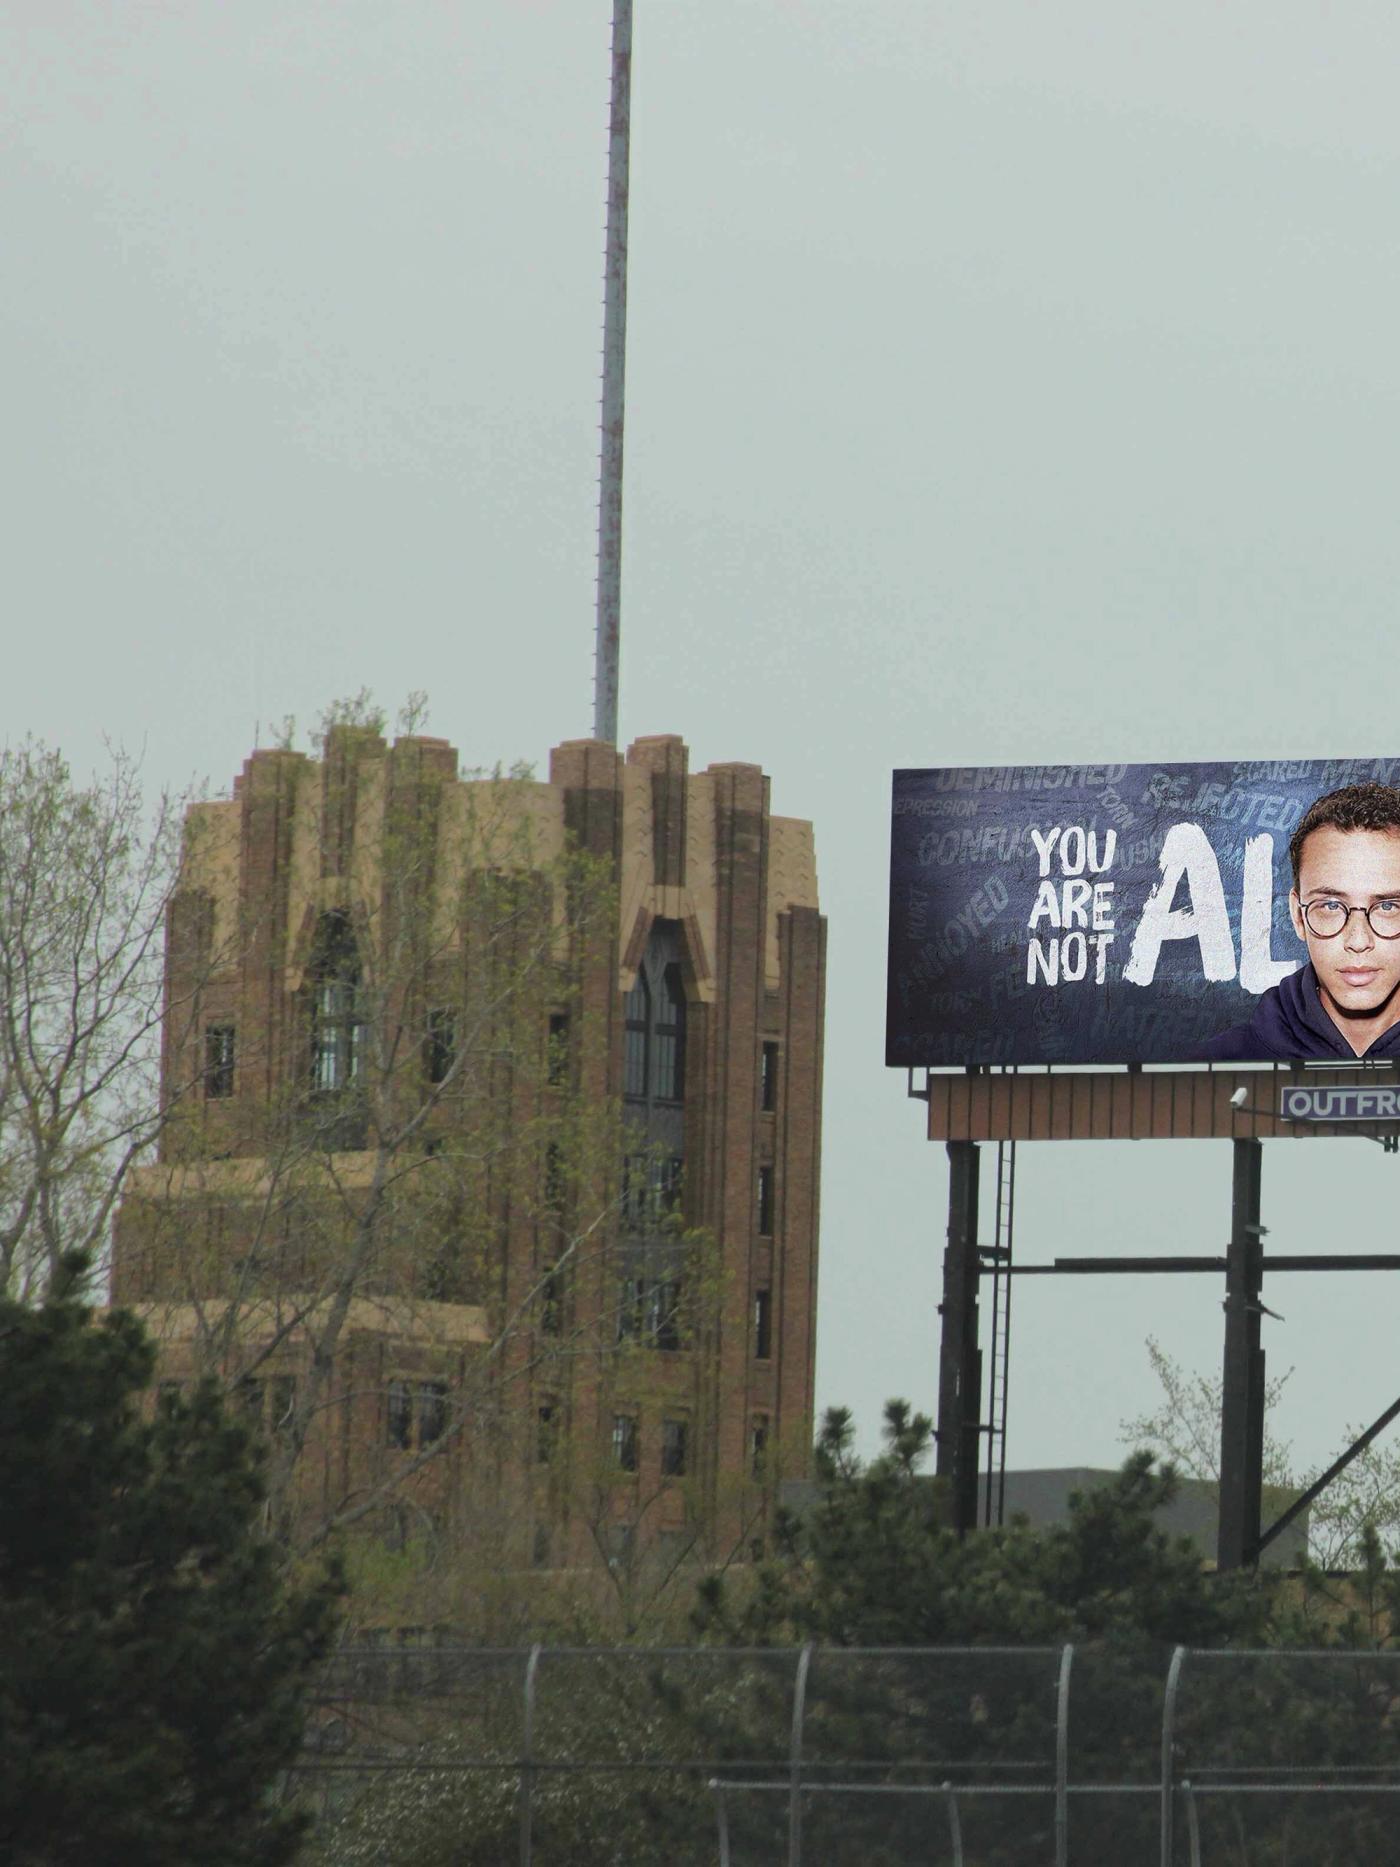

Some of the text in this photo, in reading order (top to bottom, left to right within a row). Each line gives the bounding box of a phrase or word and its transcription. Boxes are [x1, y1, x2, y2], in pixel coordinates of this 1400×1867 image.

[1031, 826, 1117, 877] YOU
[1028, 879, 1115, 930] ARE
[1027, 932, 1114, 986] NOT
